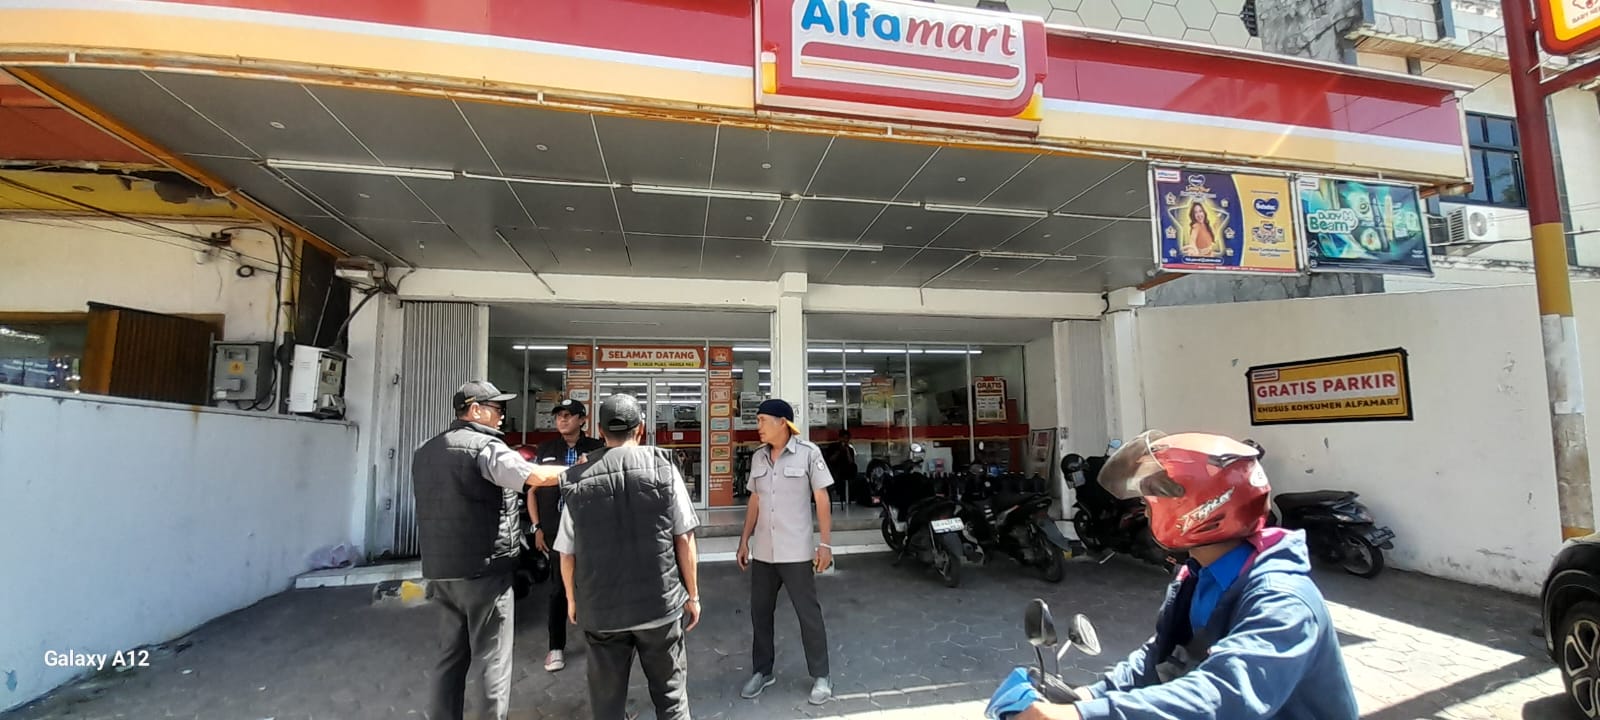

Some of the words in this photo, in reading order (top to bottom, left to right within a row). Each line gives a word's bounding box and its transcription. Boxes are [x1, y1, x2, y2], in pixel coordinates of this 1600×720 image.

[801, 0, 1017, 56] Alfamart
[1310, 216, 1348, 231] Beam
[608, 351, 653, 359] SELAMAT
[656, 351, 694, 359] DATANG
[1257, 381, 1317, 398] GRATIS
[1323, 373, 1396, 393] PARKIR
[1257, 405, 1289, 413] KHUSUS
[1291, 401, 1342, 411] KONSUMEN
[1345, 398, 1400, 408] ALFAMART
